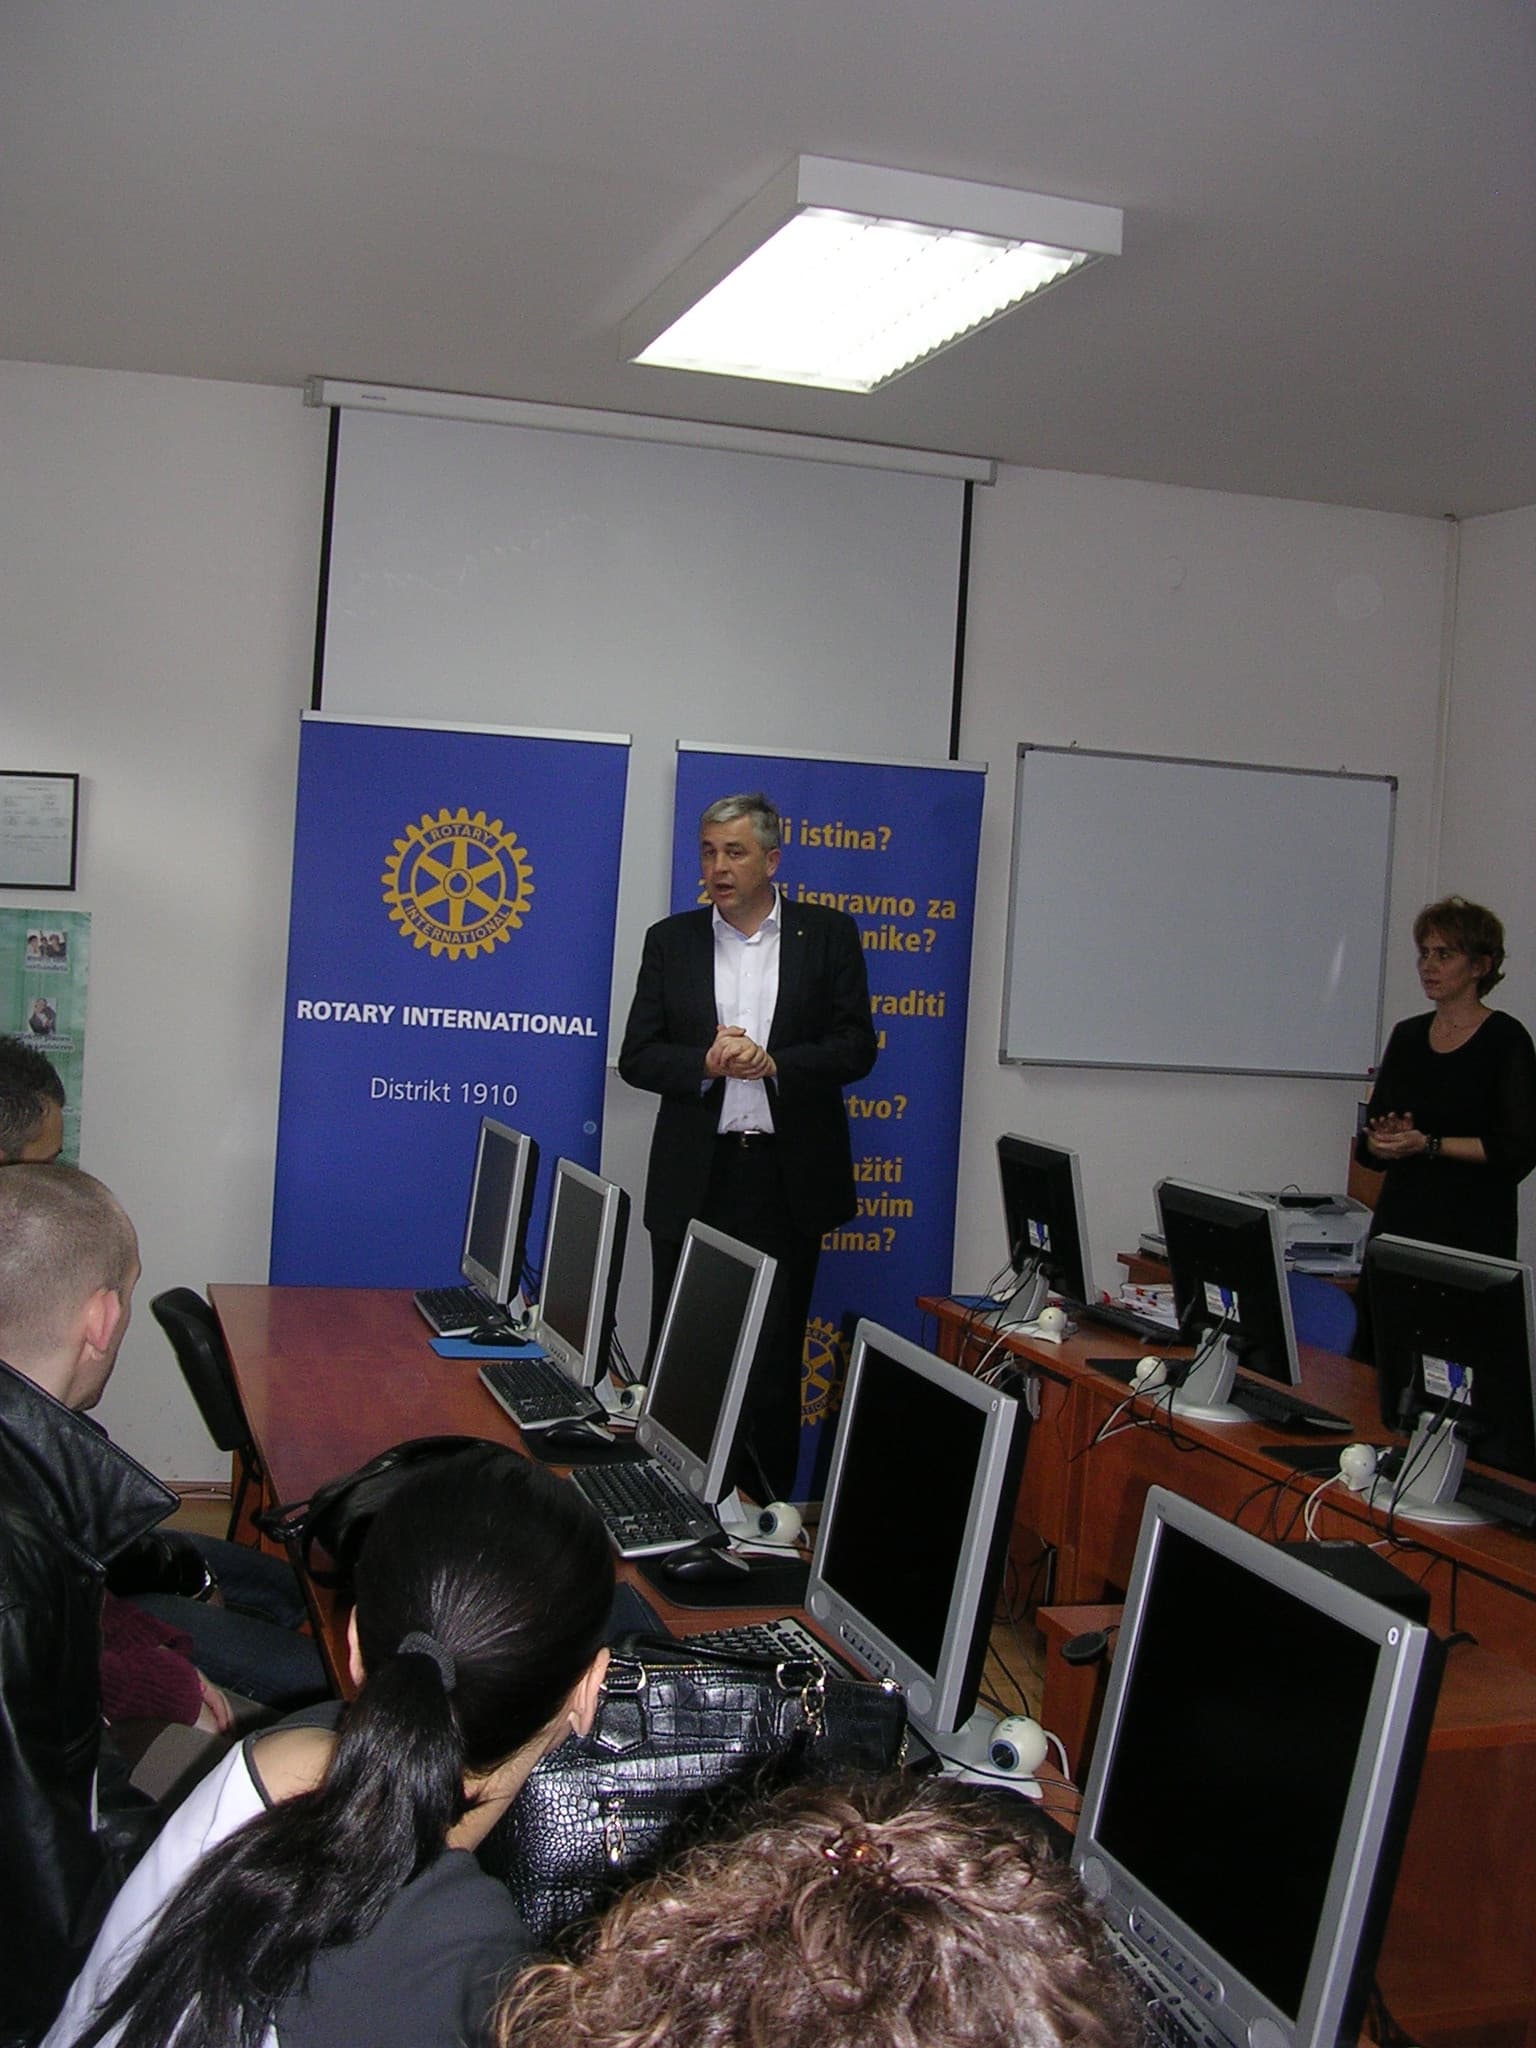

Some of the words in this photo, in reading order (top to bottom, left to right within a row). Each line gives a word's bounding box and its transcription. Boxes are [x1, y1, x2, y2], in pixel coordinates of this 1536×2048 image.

[429, 824, 493, 844] ROTARY
[800, 818, 892, 851] istina?
[405, 902, 509, 944] INTERNATIONAL
[926, 899, 956, 920] za
[861, 924, 936, 953] nike?
[870, 989, 946, 1018] raditi
[296, 1000, 395, 1025] ROTARY
[402, 1006, 599, 1037] INTERNATIONAL
[370, 1077, 451, 1103] Distrikt
[460, 1083, 518, 1106] 1910
[846, 1095, 908, 1120] tvo?
[852, 1157, 903, 1183] žiti
[820, 1227, 897, 1252] cima?
